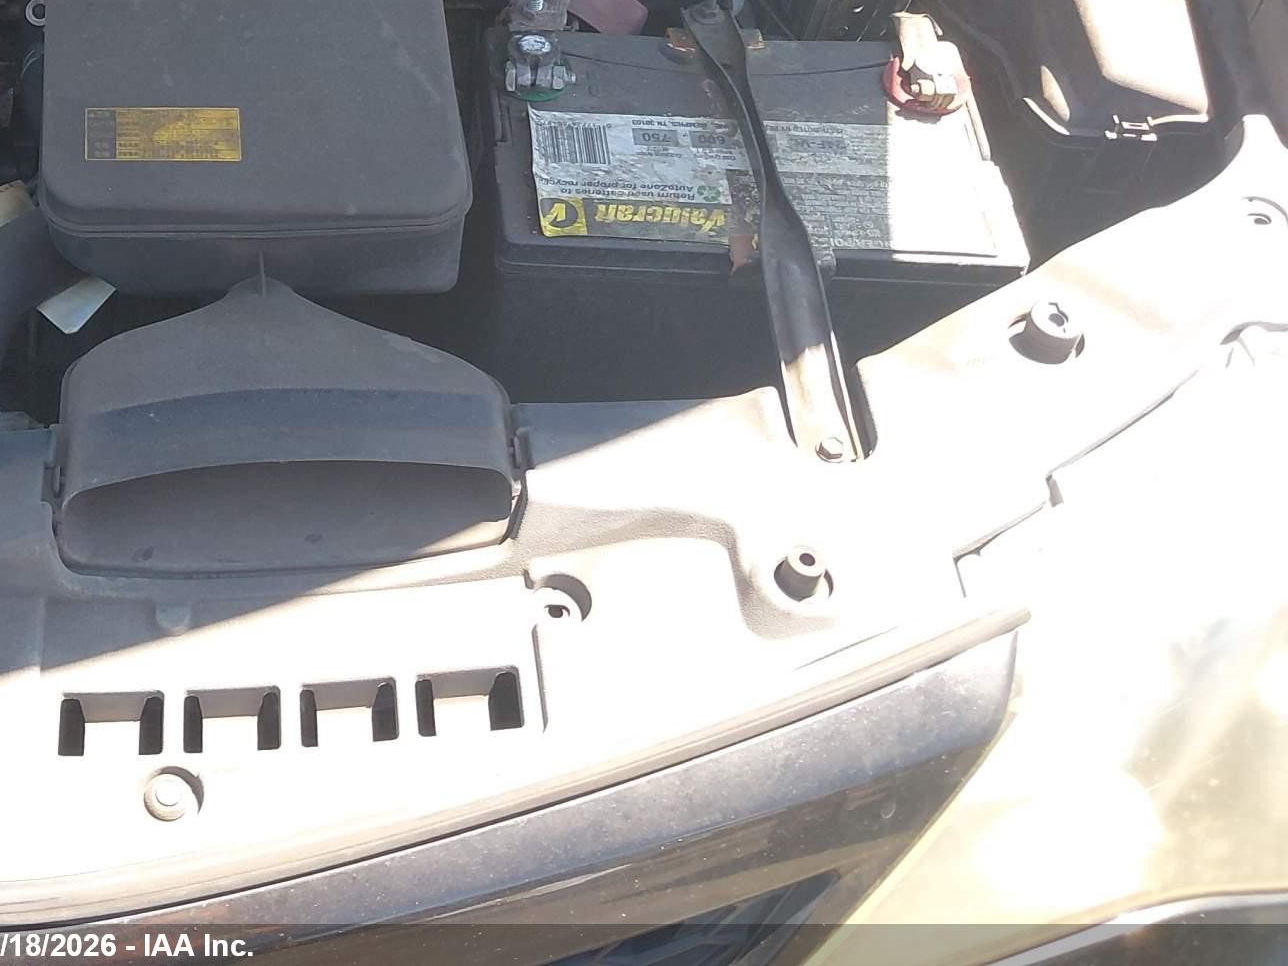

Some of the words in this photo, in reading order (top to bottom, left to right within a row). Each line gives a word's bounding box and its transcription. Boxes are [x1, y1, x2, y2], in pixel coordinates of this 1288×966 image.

[639, 183, 695, 193] AutoZone
[656, 190, 696, 201] Return
[594, 203, 728, 234] Valucraft
